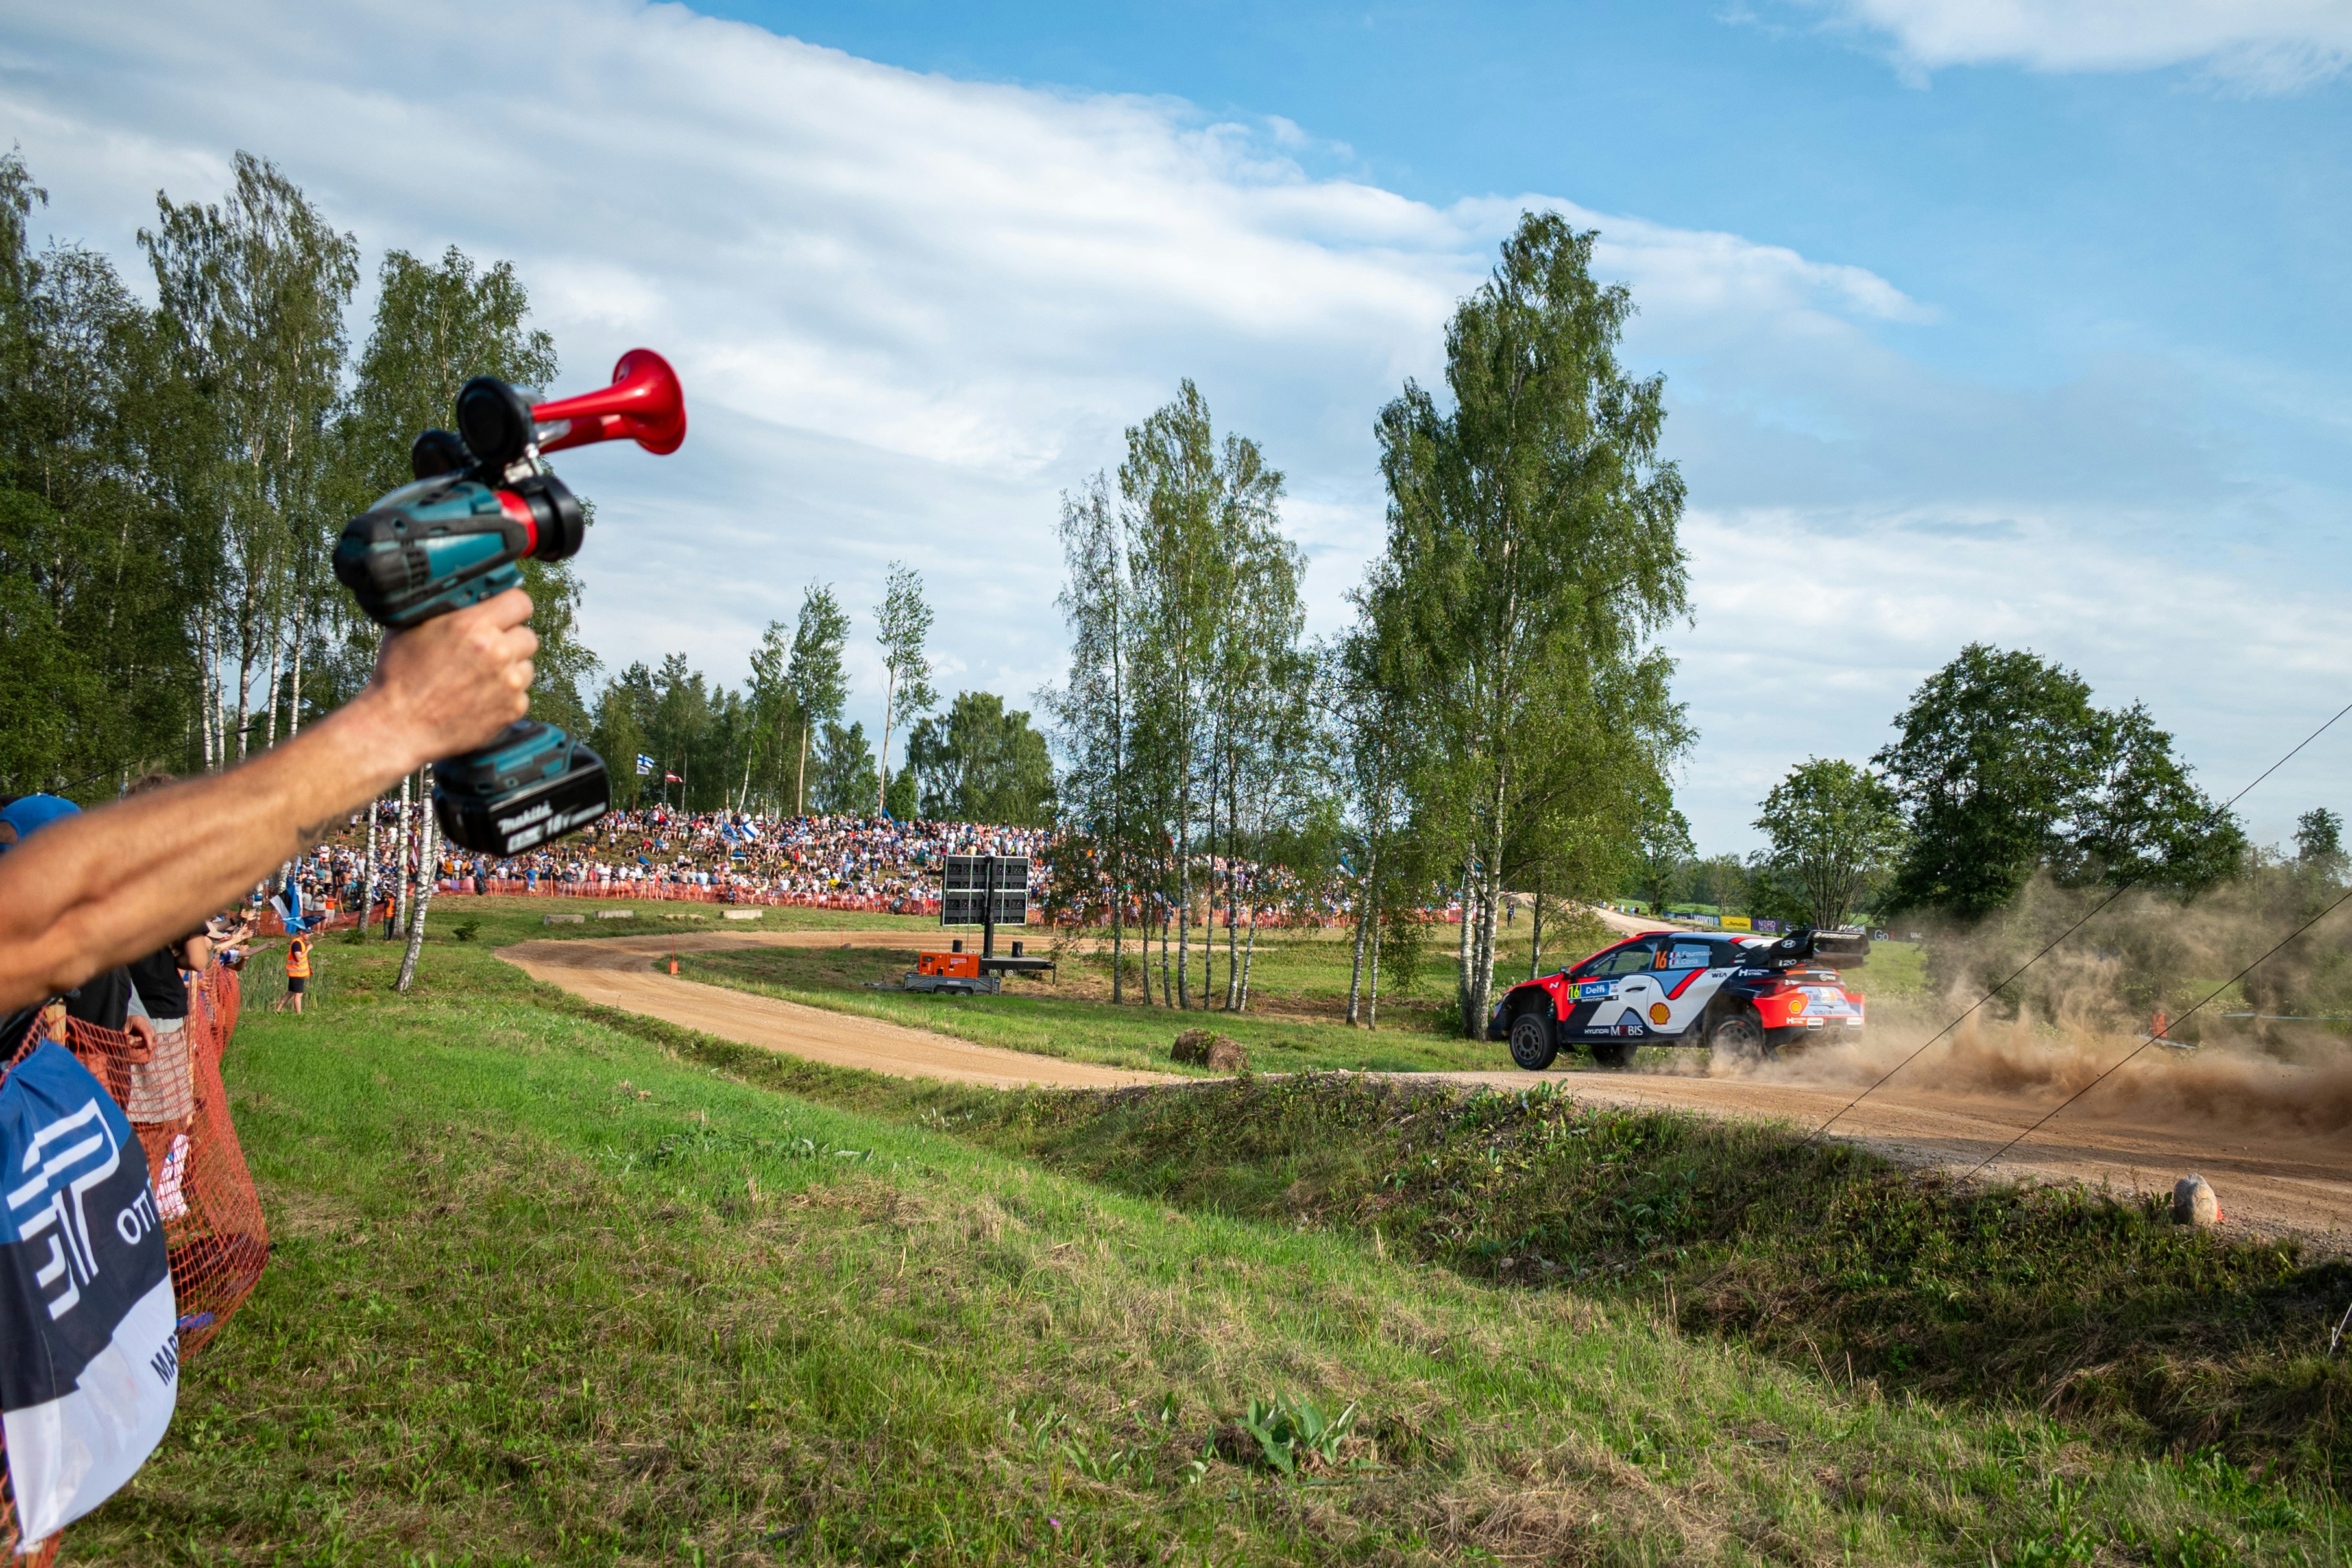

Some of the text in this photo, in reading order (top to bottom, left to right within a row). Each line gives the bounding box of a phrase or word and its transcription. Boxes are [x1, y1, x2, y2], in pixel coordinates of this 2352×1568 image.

[1655, 950, 1668, 969] 16
[1569, 985, 1605, 998] 16 Delfi
[1610, 1025, 1643, 1037] MOBIS
[150, 1328, 178, 1387] MAR
